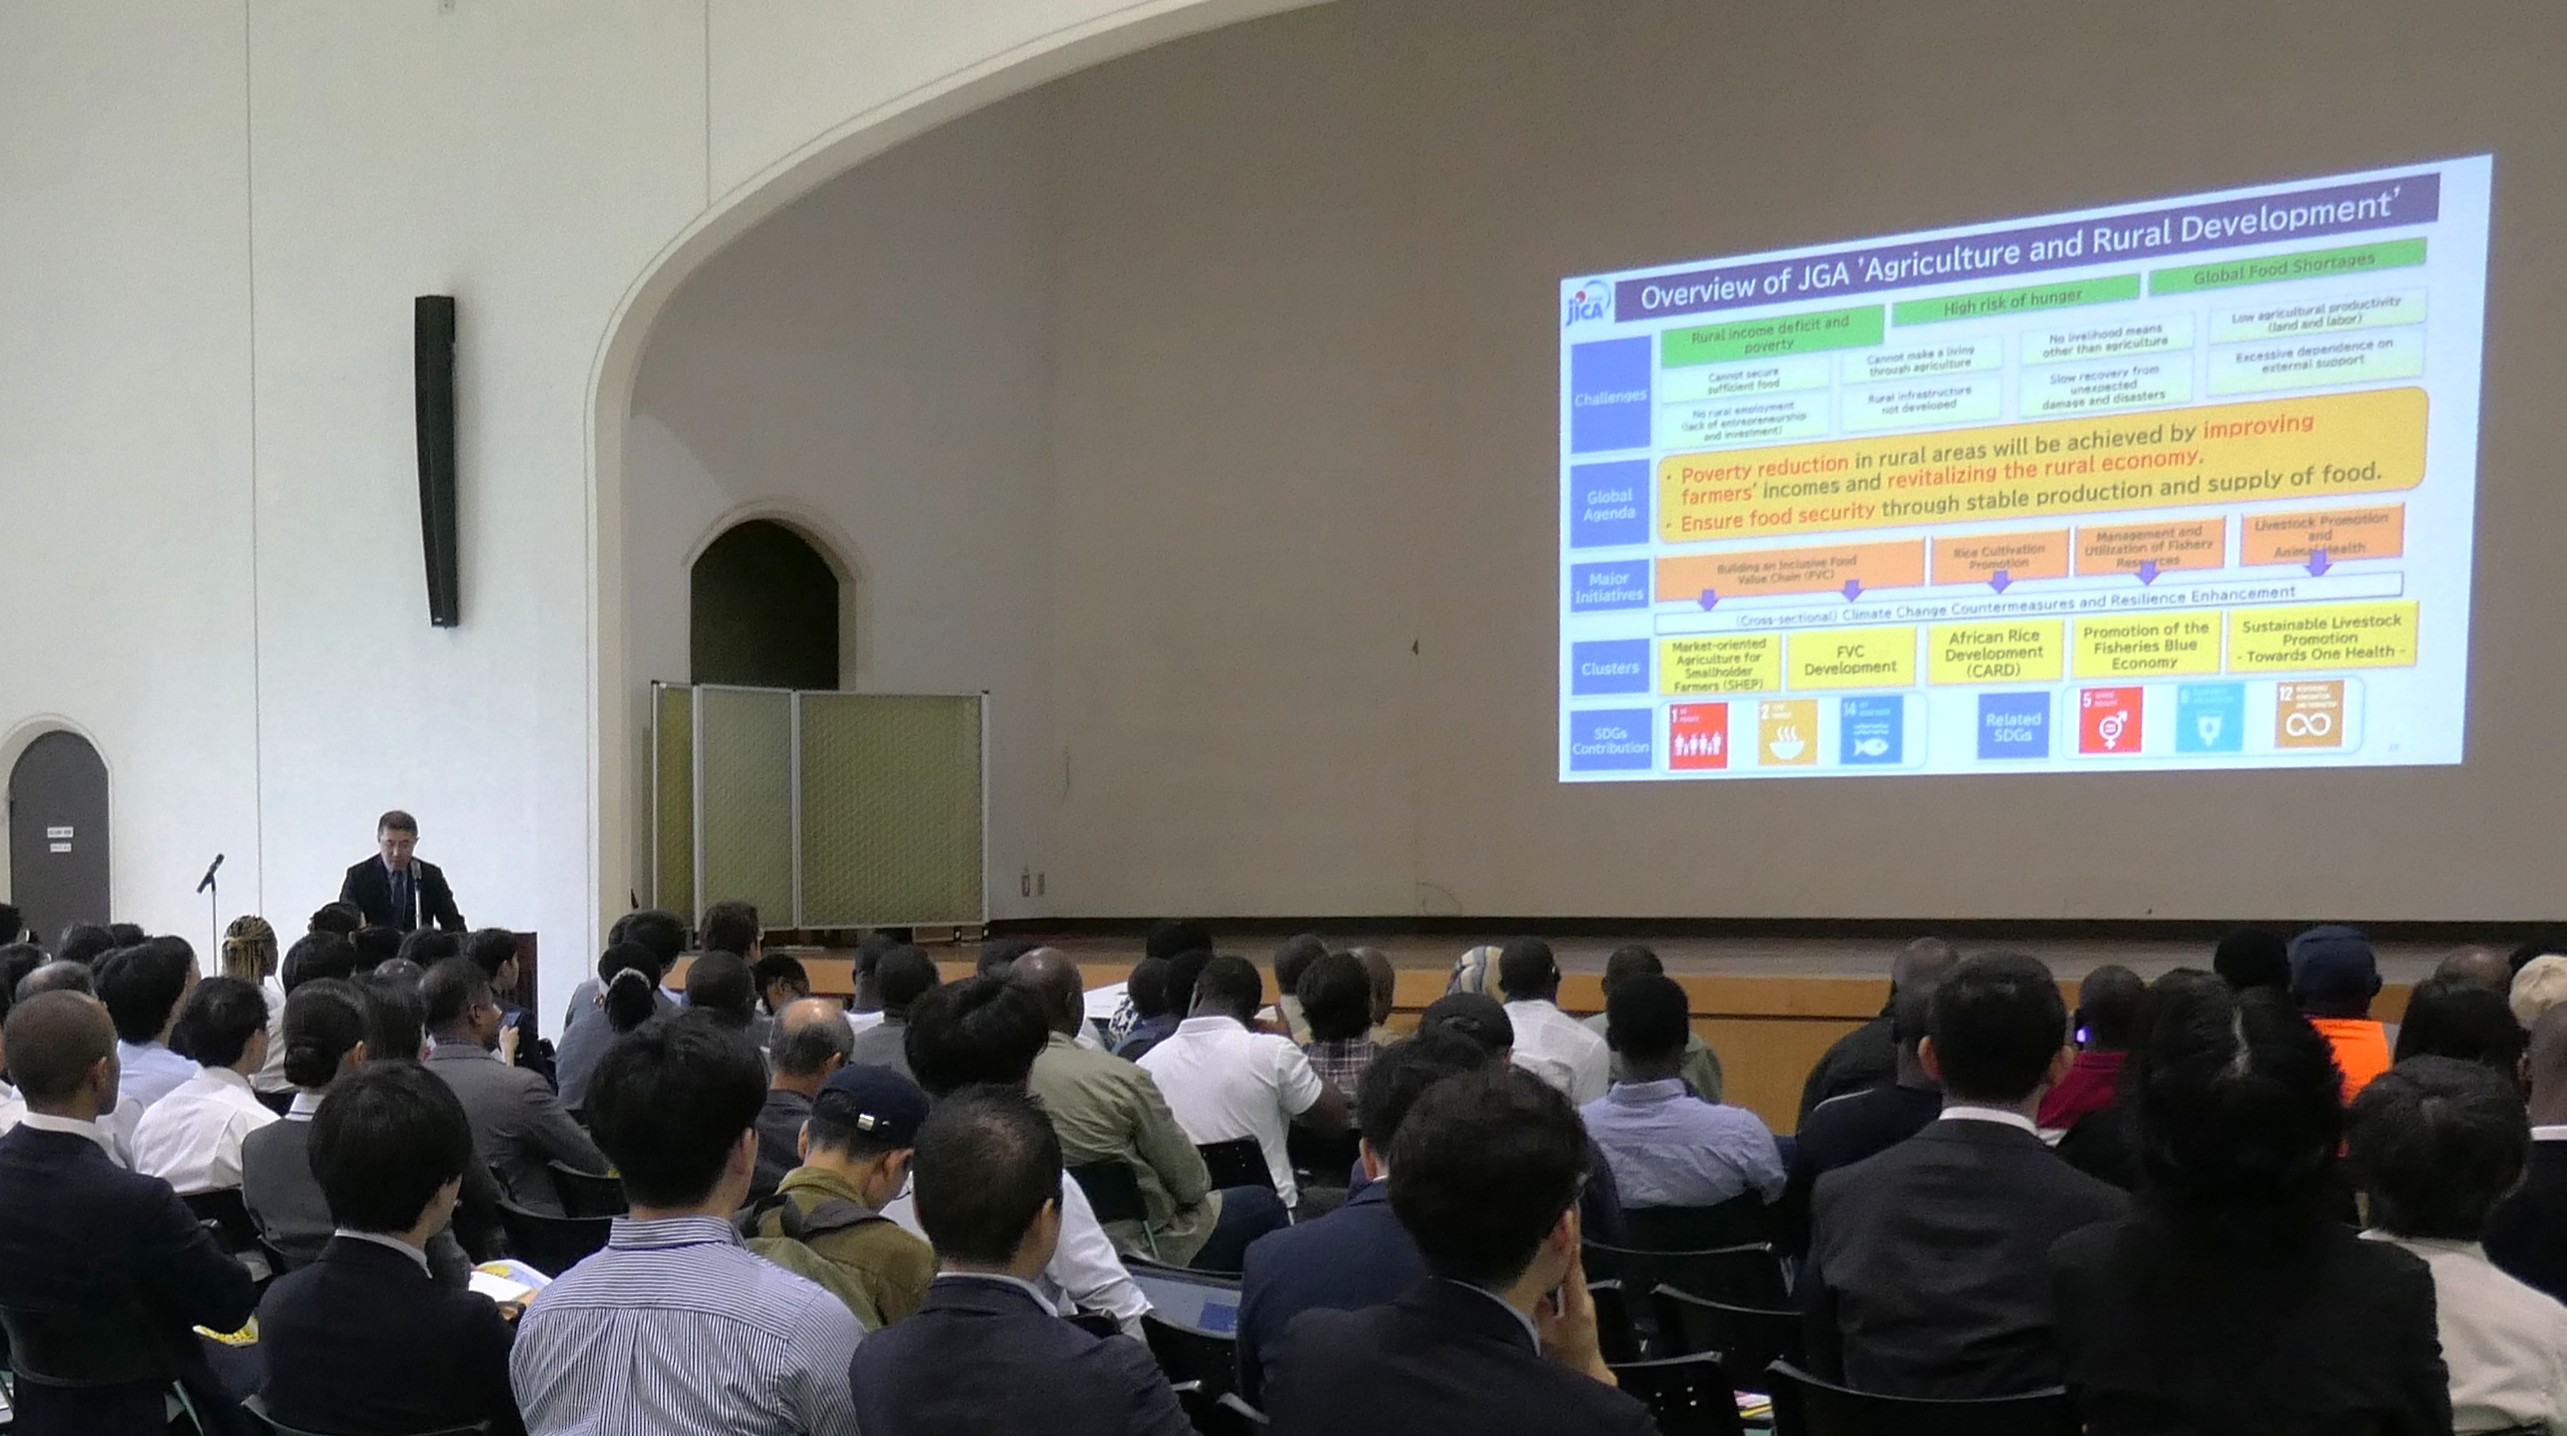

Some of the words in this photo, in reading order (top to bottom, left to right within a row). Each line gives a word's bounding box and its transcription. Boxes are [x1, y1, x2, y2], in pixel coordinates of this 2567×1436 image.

[1641, 278, 1755, 309] Overview
[1764, 266, 1791, 294] of
[1798, 263, 1850, 291] JGA
[2029, 230, 2082, 262] and
[2094, 218, 2171, 253] Rural
[2194, 268, 2245, 286] Global
[2249, 262, 2288, 279] Food
[2293, 252, 2375, 274] Shortages
[1944, 301, 1976, 316] High
[1980, 297, 2006, 312] risk
[2011, 294, 2027, 307] of
[2031, 288, 2083, 308] hunger
[2232, 313, 2255, 325] Low
[2258, 303, 2325, 322] agricultural
[2328, 296, 2401, 314] productivity
[1691, 330, 1726, 345] Rural
[1728, 325, 1775, 340] income
[1778, 319, 1822, 336] deficit
[1825, 315, 1850, 330] and
[2268, 321, 2298, 334] (land
[2301, 317, 2324, 329] and
[2327, 314, 2362, 328] labor)
[2050, 334, 2065, 345] No
[2068, 327, 2123, 343] livelihood
[2126, 323, 2162, 337] means
[1744, 338, 1794, 355] poverty
[1867, 352, 1904, 366] Cannot
[1907, 350, 1934, 361] make
[1946, 344, 1975, 358] living
[2043, 347, 2073, 359] other
[2076, 343, 2102, 355] than
[2105, 336, 2168, 353] agriculture
[2235, 349, 2293, 364] Excessive
[2297, 340, 2373, 357] dependence
[2377, 339, 2393, 349] on
[1869, 362, 1911, 377] through
[1914, 357, 1972, 374] agriculture
[2262, 360, 2313, 374] external
[2316, 355, 2365, 370] support
[1708, 371, 1743, 383] Cannot
[1746, 368, 1779, 379] secure
[2050, 373, 2076, 385] Slow
[2079, 367, 2129, 382] recovery
[2132, 365, 2160, 376] from
[1708, 381, 1754, 395] sufficient
[1758, 378, 1780, 389] food
[1868, 393, 1895, 405] Rural
[1897, 385, 1972, 402] infrastructure
[2071, 379, 2137, 396] unexpected
[1574, 389, 1648, 407] Challenges
[1881, 404, 1900, 415] not
[1901, 398, 1957, 413] developed
[2042, 398, 2085, 411] damage
[2088, 395, 2110, 406] and
[2113, 389, 2166, 405] disasters
[1708, 407, 1731, 417] rural
[1735, 402, 1794, 415] employment
[1704, 431, 1722, 441] and
[1681, 461, 1752, 484] Poverty
[1758, 455, 1848, 477] reduction
[1856, 452, 1873, 469] in
[1879, 446, 1926, 467] rural
[1932, 445, 1987, 462] areas
[1993, 437, 2028, 457] will
[2035, 435, 2061, 453] be
[2068, 425, 2162, 450] achieved
[2170, 423, 2197, 443] by
[2204, 414, 2314, 439] improving
[1763, 475, 1839, 499] incomes
[1846, 473, 1881, 492] and
[1887, 464, 1997, 489] revitalizing
[2004, 461, 2037, 480] the
[2045, 455, 2095, 476] rural
[2102, 450, 2204, 472] economy.
[1587, 487, 1633, 505] Global
[1681, 513, 1744, 532] Ensure
[1750, 507, 1793, 527] food
[1799, 501, 1876, 525] security
[1882, 494, 1960, 517] through
[1966, 490, 2029, 511] stable
[2037, 481, 2152, 507] production
[2160, 475, 2200, 496] and
[2208, 469, 2283, 492] supply
[2290, 466, 2315, 486] of
[2322, 460, 2382, 484] food.
[1584, 506, 1636, 523] Agenda
[2255, 514, 2315, 532] Livestock
[2320, 512, 2389, 527] Promotion
[2097, 528, 2176, 543] Management
[2179, 525, 2203, 537] and
[2308, 530, 2332, 542] and
[1954, 547, 1978, 559] Rice
[1982, 543, 2045, 557] Cultivation
[2085, 541, 2147, 556] Utilization
[2151, 540, 2164, 551] of
[2168, 538, 2213, 552] Fishery
[1717, 559, 1761, 574] Building
[1763, 561, 1777, 571] an
[1778, 557, 1827, 571] Inclusive
[1830, 555, 1857, 568] Food
[1969, 558, 2029, 570] Promotion
[1589, 571, 1630, 587] Major
[1738, 573, 1767, 585] Value
[1770, 570, 1801, 583] Chain
[1804, 568, 1835, 582] (FVC)
[1576, 586, 1644, 604] Initiatives
[1736, 608, 1838, 627] (Cross-sectional)
[1842, 605, 1892, 622] Climate
[1896, 603, 1946, 619] Change
[1952, 598, 2075, 615] Countermeasures
[2080, 595, 2106, 609] and
[2111, 590, 2185, 606] Resilience
[2192, 586, 2296, 602] Enhancement
[2084, 624, 2159, 638] Promotion
[2163, 622, 2180, 636] of
[2184, 621, 2209, 634] the
[2242, 617, 2327, 633] Sustainable
[2332, 614, 2402, 630] Livestock
[1672, 638, 1766, 652] Market-oriented
[1949, 629, 2003, 645] African
[2008, 629, 2040, 642] Rice
[2283, 632, 2358, 646] Promotion
[1836, 646, 1864, 659] FVC
[1945, 646, 2043, 662] Development
[2094, 640, 2159, 654] Fisheries
[2165, 638, 2197, 651] Blue
[2247, 648, 2307, 663] Towards
[2311, 647, 2341, 660] One
[2345, 644, 2395, 659] Health
[1677, 652, 1740, 666] Agriculture
[1744, 651, 1762, 663] for
[2112, 657, 2177, 670] Economy
[1582, 661, 1640, 676] Clusters
[1685, 665, 1753, 679] Smallholder
[1805, 660, 1897, 676] Development
[1967, 663, 2021, 678] (CARD)
[1674, 681, 1720, 692] Farmers
[1723, 678, 1763, 692] (SHEP)
[2279, 686, 2294, 701] 12
[2083, 693, 2092, 708] 5
[1760, 703, 1770, 720] 2
[1986, 712, 2042, 726] Related
[1594, 727, 1628, 741] SDGs
[1994, 728, 2032, 742] SDGs
[1572, 740, 1650, 755] Contribution
